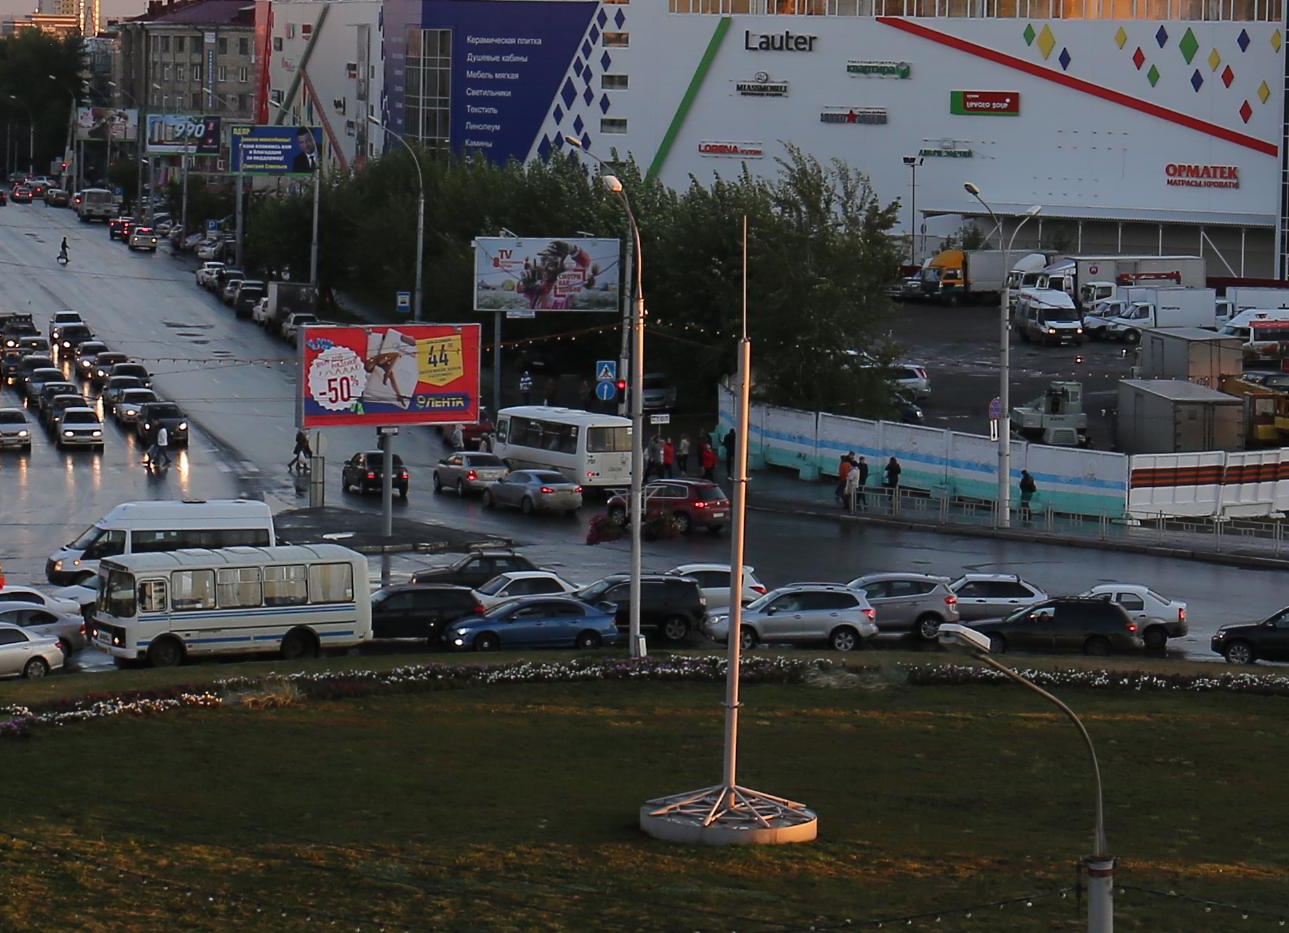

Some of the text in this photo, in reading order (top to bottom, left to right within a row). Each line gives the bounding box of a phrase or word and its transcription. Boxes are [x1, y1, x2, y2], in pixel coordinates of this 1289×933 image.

[745, 30, 817, 51] Lauter
[466, 70, 493, 79] Мебель
[466, 88, 512, 97] Светильники
[466, 105, 498, 114] Текстиль
[175, 124, 204, 137] 990
[465, 122, 500, 132] Линолеум
[465, 139, 493, 148] Камины
[1166, 164, 1238, 179] ОРМАТЕК
[499, 250, 513, 259] TV
[428, 344, 449, 368] 44
[425, 397, 465, 408] ЛЕНТА
